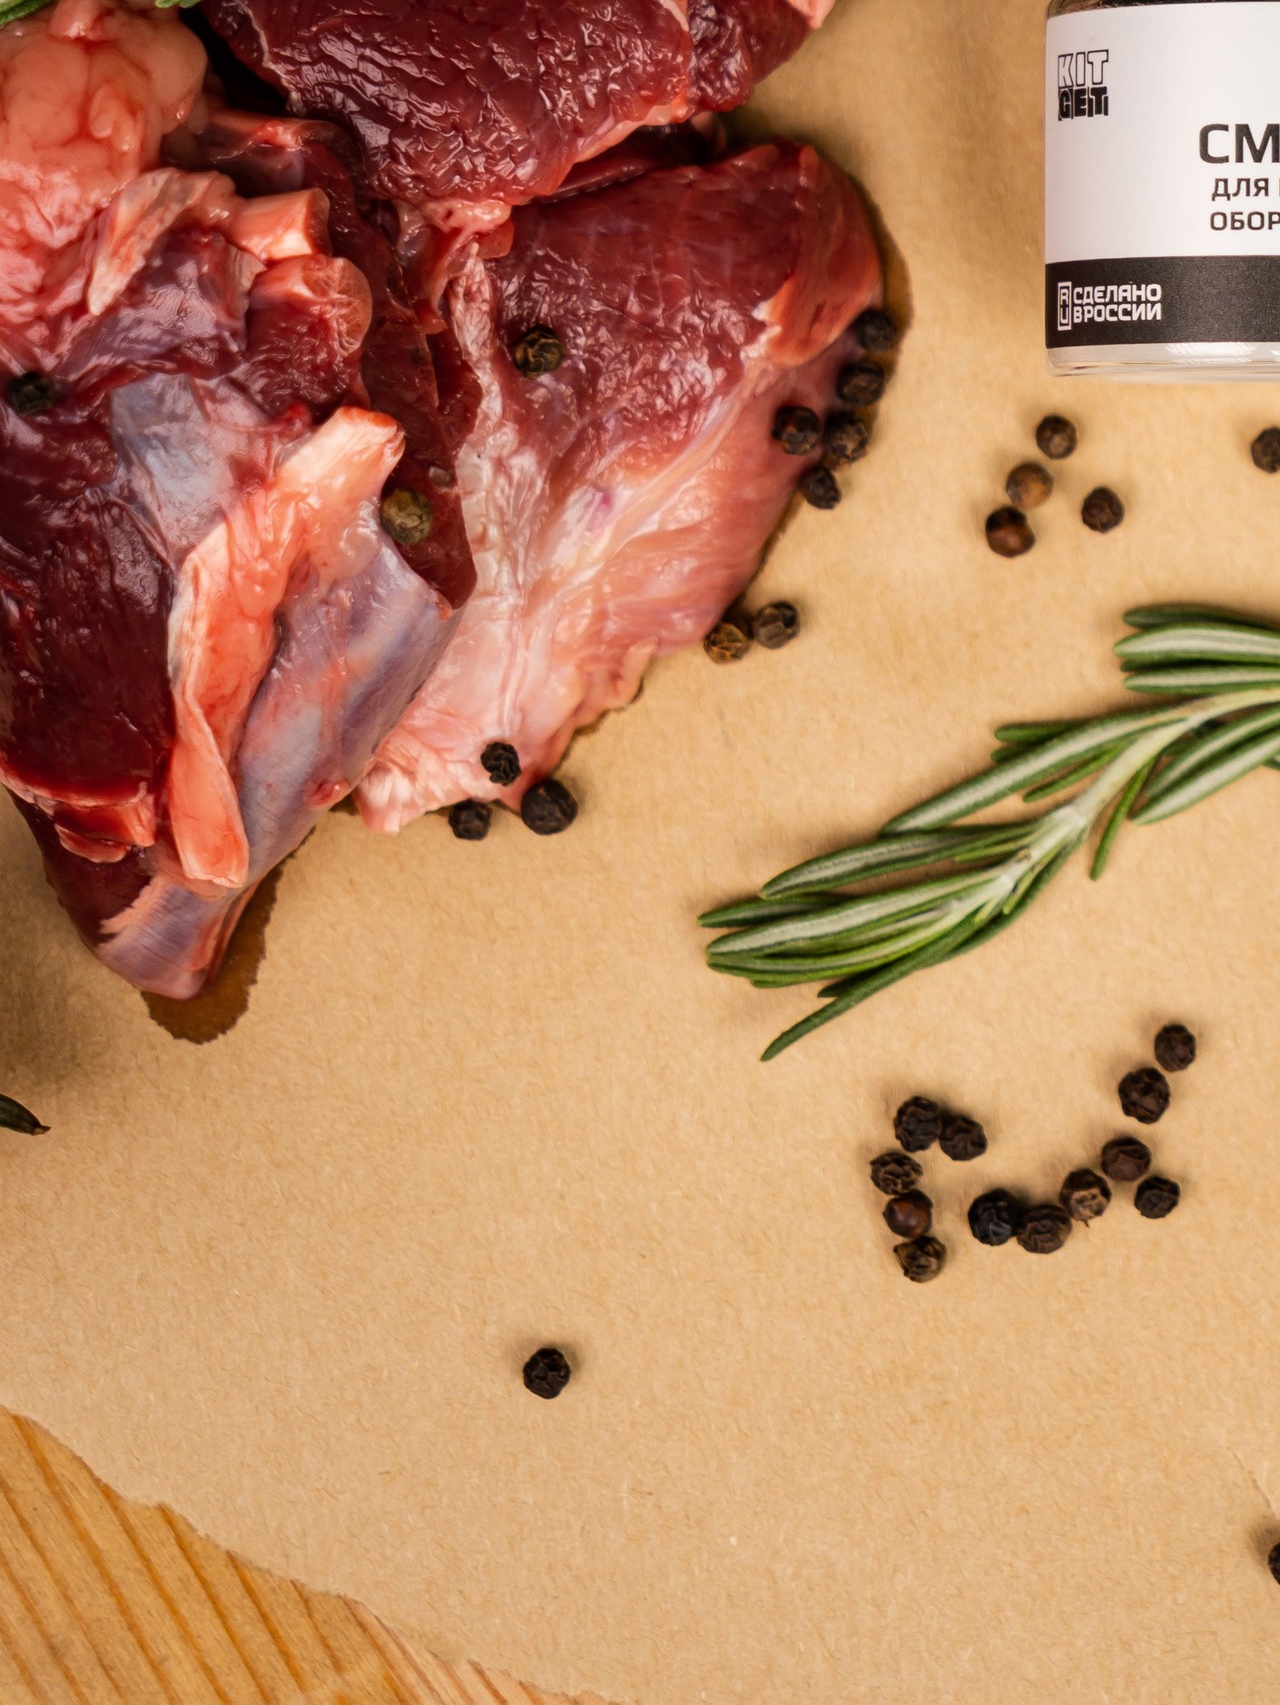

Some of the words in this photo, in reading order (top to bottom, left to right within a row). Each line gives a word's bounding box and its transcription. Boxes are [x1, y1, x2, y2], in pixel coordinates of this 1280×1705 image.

[1057, 49, 1109, 89] KIT
[1057, 86, 1109, 122] GET
[1212, 178, 1269, 202] ДЛЯ
[1073, 283, 1162, 305] СДЕЛАНО
